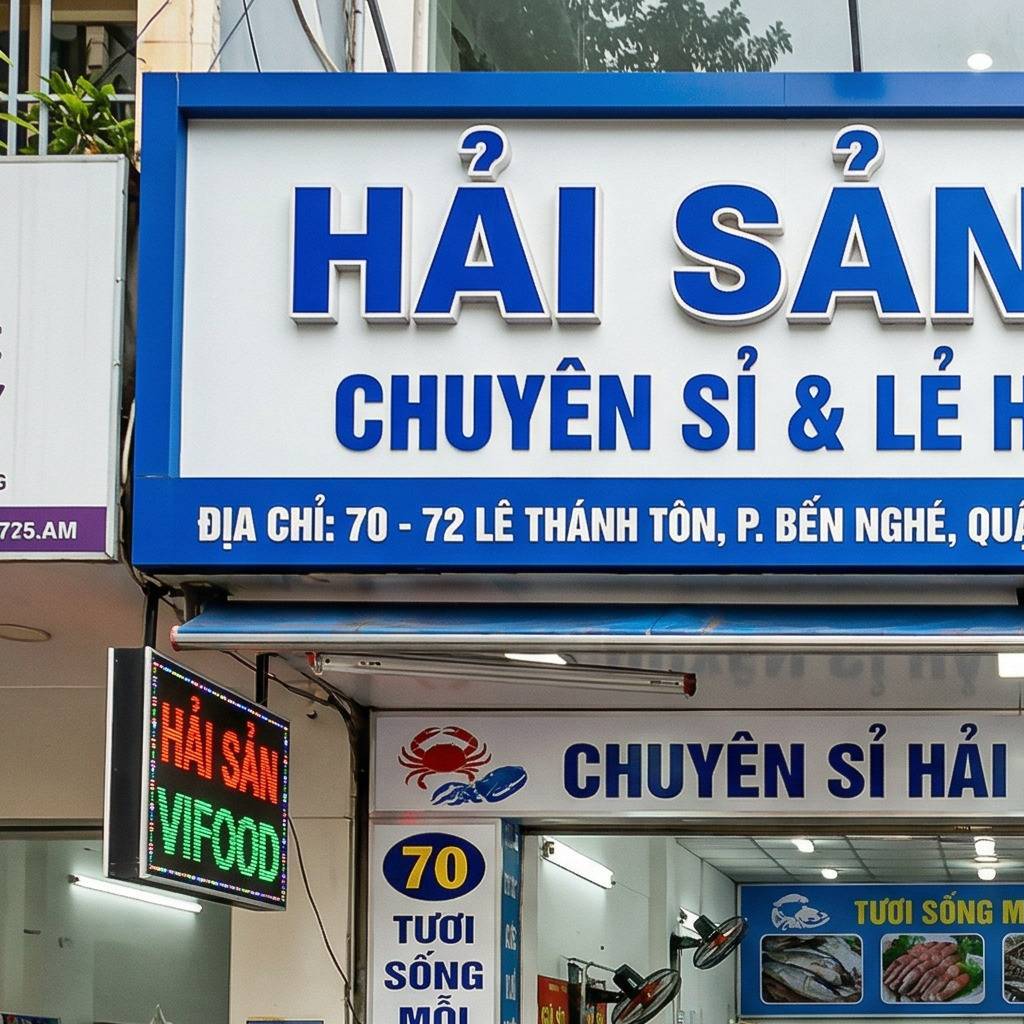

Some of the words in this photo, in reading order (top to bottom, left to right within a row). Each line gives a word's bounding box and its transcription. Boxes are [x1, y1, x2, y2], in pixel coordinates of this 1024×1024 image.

[291, 127, 600, 319] HẢI
[335, 357, 652, 453] CHUYÊN
[681, 345, 758, 452] SỈ
[787, 374, 845, 453] &
[876, 345, 962, 452] LẺ
[197, 506, 257, 551] ĐỊA
[267, 494, 335, 542] CHỈ:
[346, 506, 388, 542] 70
[399, 522, 411, 530] -
[422, 507, 464, 542] 72
[476, 499, 514, 542] LÊ
[524, 499, 638, 542] THÁNH
[649, 499, 726, 548] TÔN,
[737, 507, 763, 542] P.
[776, 495, 843, 542] BẾN
[855, 499, 957, 548] NGHÉ,
[160, 695, 213, 781] HẢI
[221, 721, 279, 805] SẢN
[563, 730, 804, 799] CHUYÊN
[828, 723, 886, 799] SỈ
[907, 723, 1008, 799] HẢI
[156, 786, 280, 883] VIFOOD
[401, 845, 468, 890] 70
[393, 914, 476, 944] TƯƠI
[853, 896, 913, 925] TƯƠI
[922, 890, 994, 926] SỐNG
[383, 950, 484, 991] SỐNG
